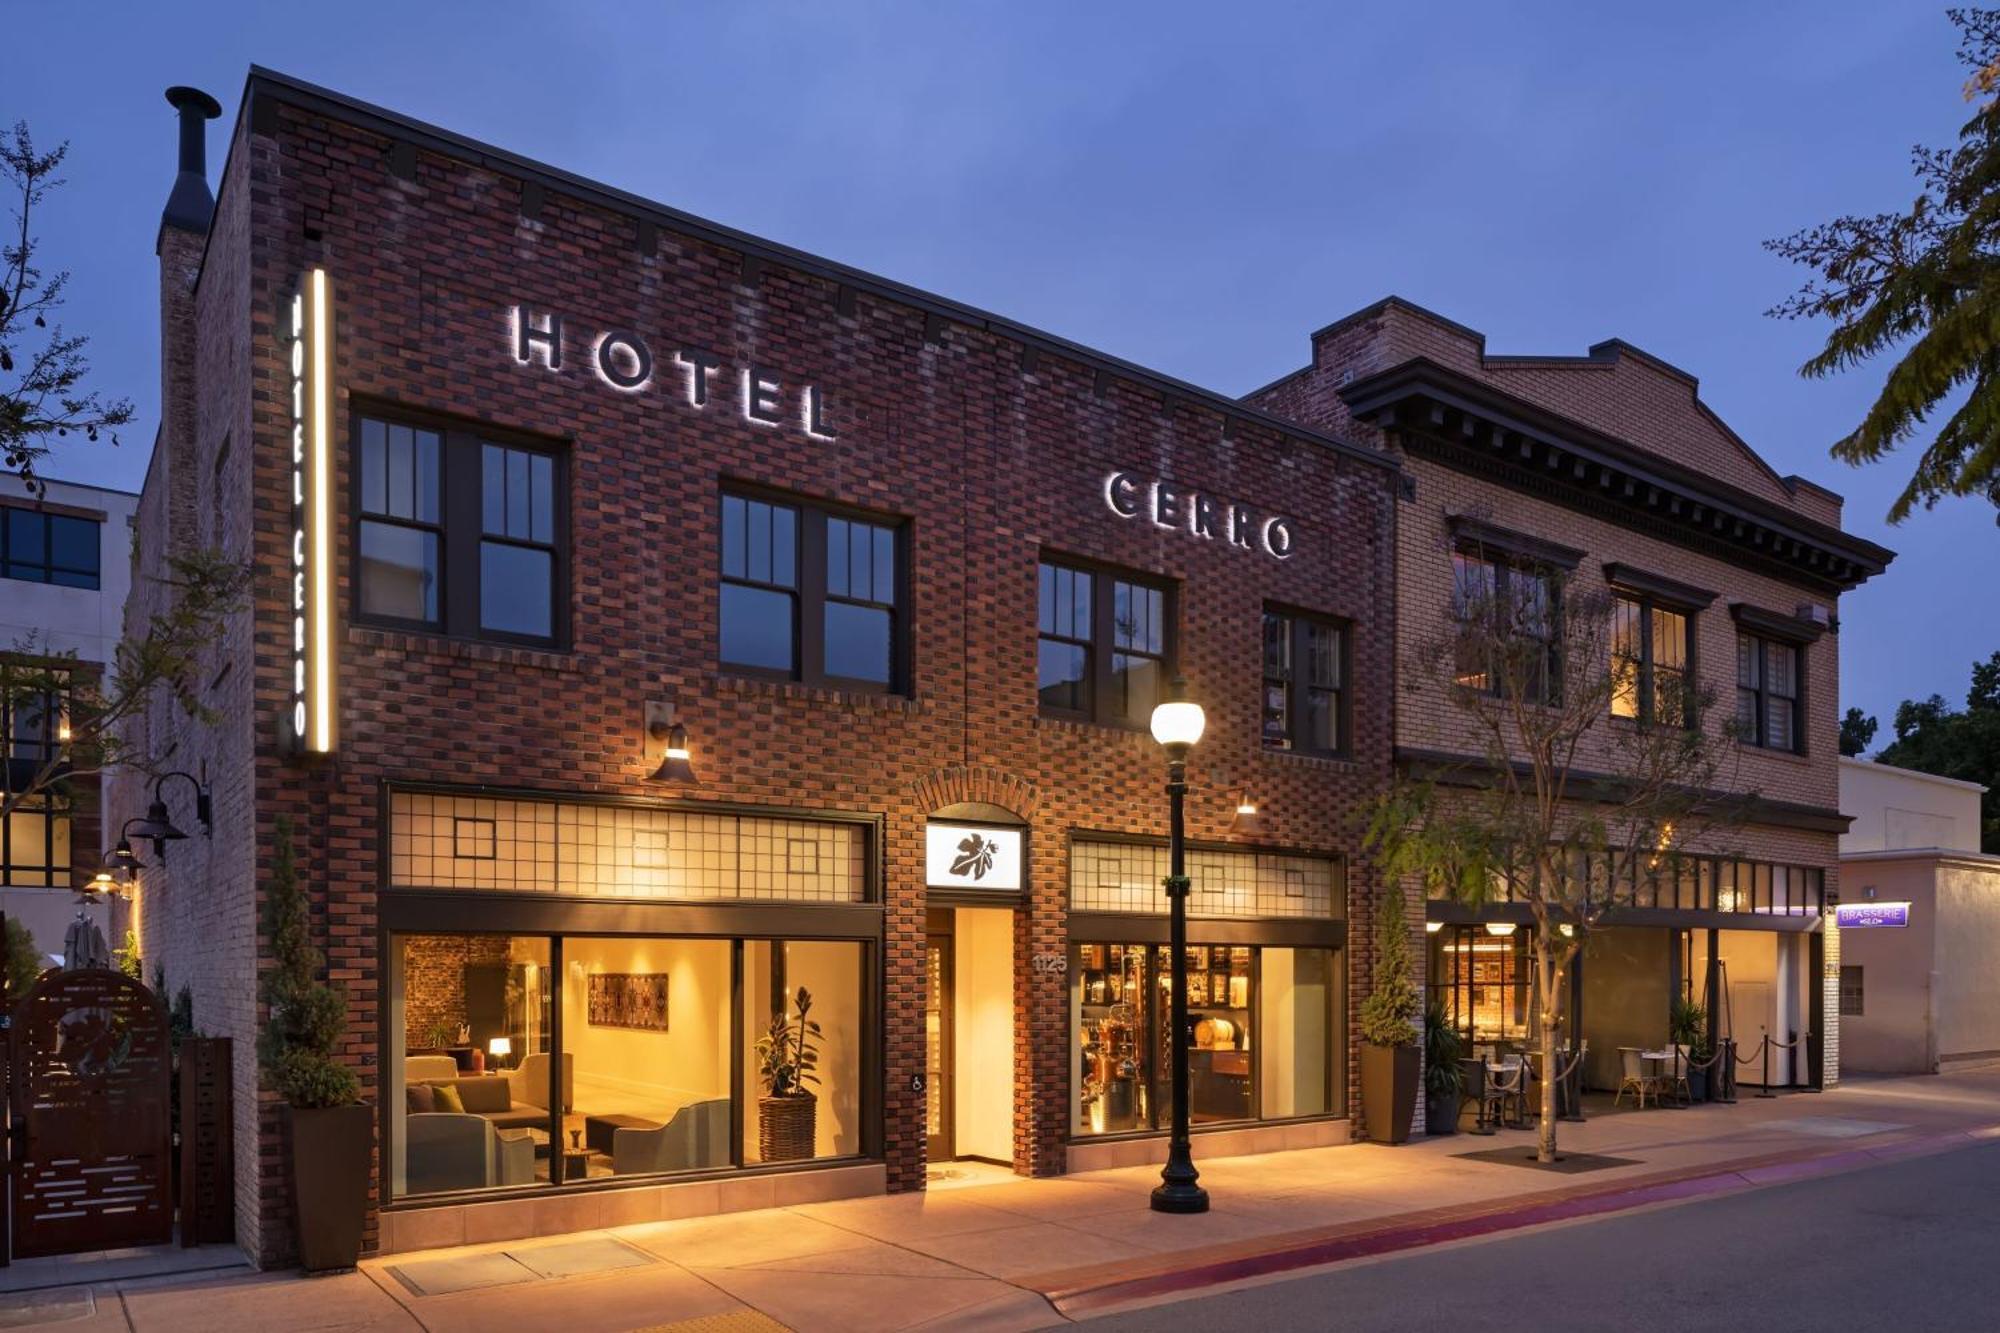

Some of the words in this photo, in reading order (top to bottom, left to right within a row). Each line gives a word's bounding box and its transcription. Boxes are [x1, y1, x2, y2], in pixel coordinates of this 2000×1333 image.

[292, 294, 304, 506] HOTEL
[510, 304, 836, 442] HOTEL
[1104, 472, 1294, 560] CERRO
[293, 529, 305, 738] CERRO
[1032, 955, 1067, 972] 1125
[1841, 908, 1901, 921] BRASSERIE
